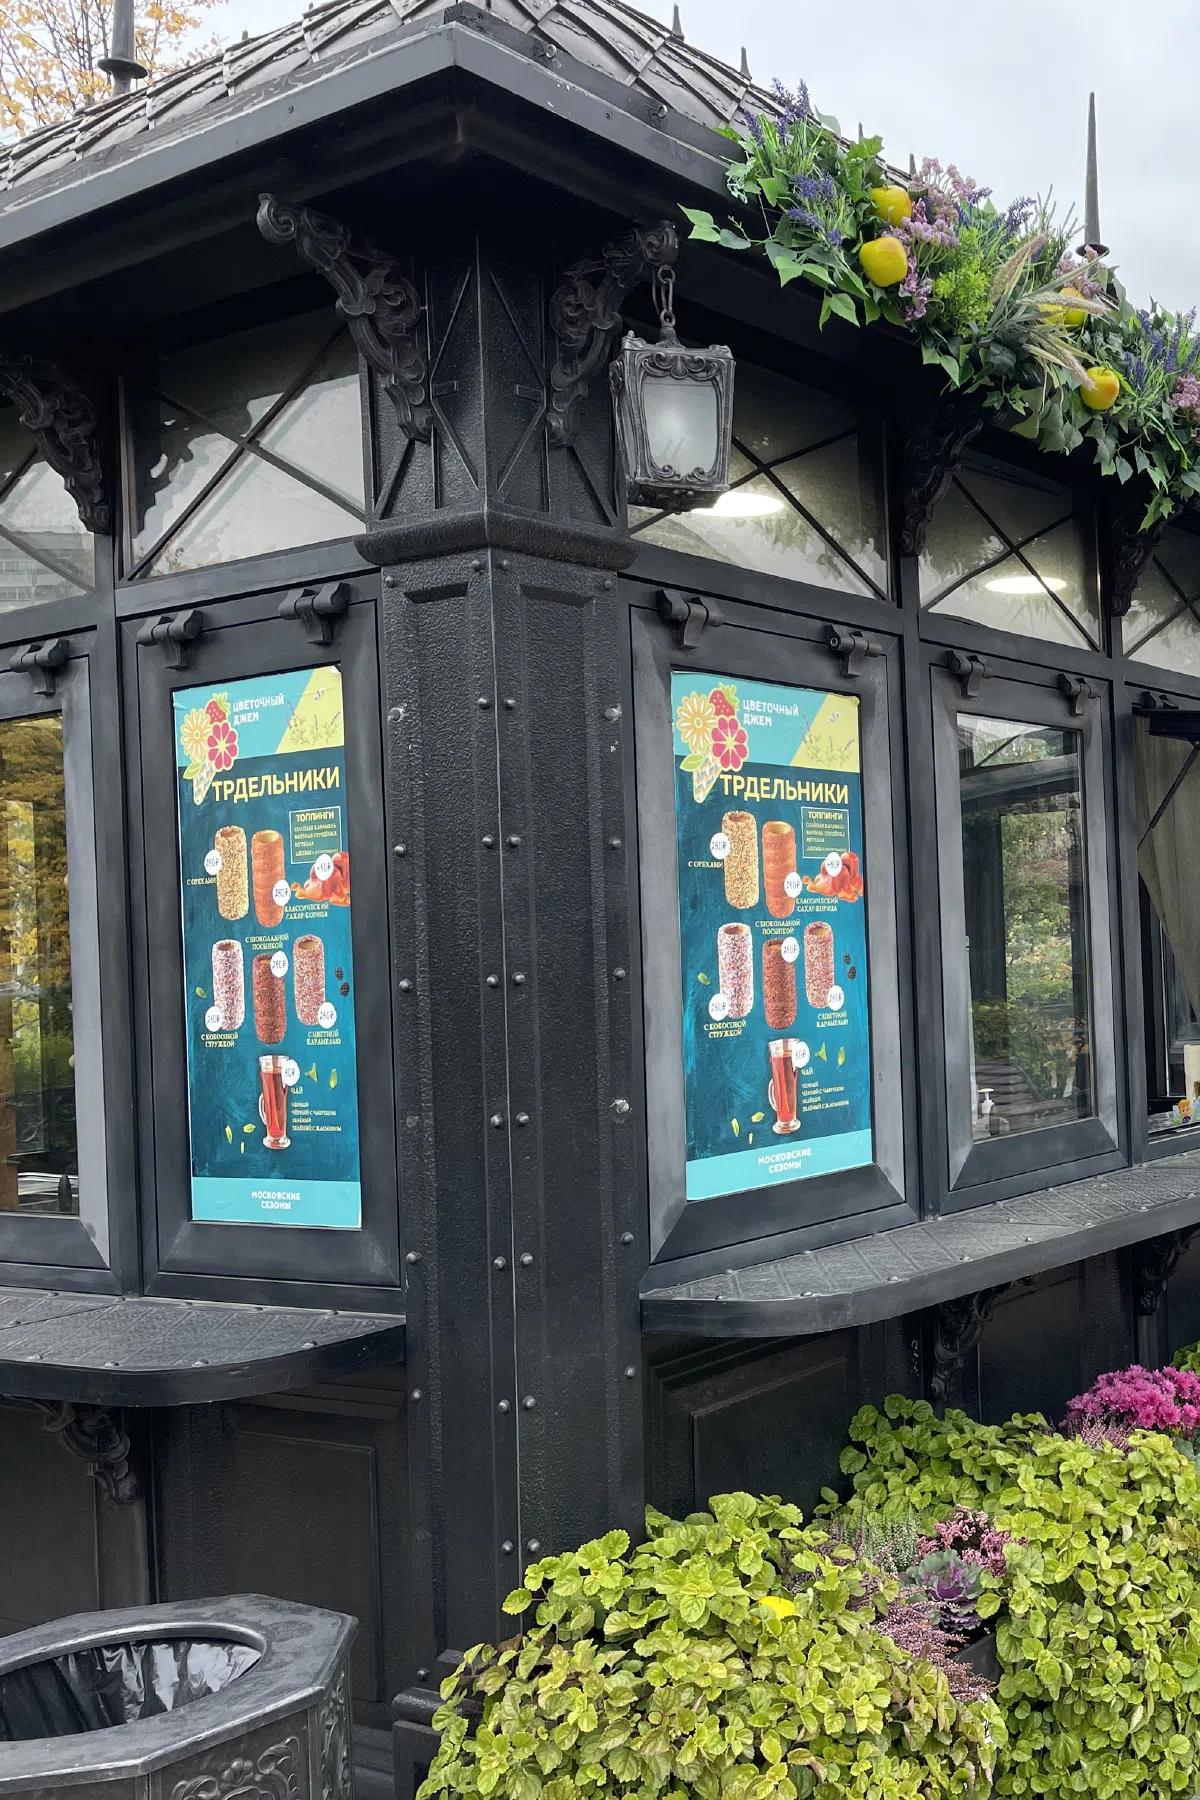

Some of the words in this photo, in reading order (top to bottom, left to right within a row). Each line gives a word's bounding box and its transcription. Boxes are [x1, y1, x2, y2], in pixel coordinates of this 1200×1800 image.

[233, 693, 284, 712] ЦВЕТОЧНЫЙ
[743, 700, 799, 717] ЦВЕТОЧНЫЙ
[233, 711, 259, 726] ДЖЕМ
[743, 713, 772, 727] ДЖЕМ
[212, 766, 340, 803] ТРДЕЛЬНИКИ
[720, 774, 849, 804] ТРДЕЛЬНИКИ
[296, 811, 334, 823] ТОППИНГИ
[808, 811, 843, 820] ТОППИНГИ
[796, 896, 838, 904] КЛАССИЧЕСКИЙ
[285, 902, 328, 912] КЛАССИЧЕСКИЙ
[760, 920, 800, 928] ШОКОЛАДНОЙ
[762, 927, 794, 935] ПОСЫПКОЙ
[250, 933, 289, 942] ШОКОЛАДНОЙ
[252, 942, 283, 950] ПОСЫПКОЙ
[709, 1019, 746, 1030] КОКОСОВОЙ
[206, 1032, 238, 1040] КОКОСОВОЙ
[312, 1029, 339, 1037] ЦВЕТНОЙ
[709, 1029, 742, 1039] СТРУЖКОЙ
[205, 1039, 234, 1048] СТРУЖКОЙ
[801, 1067, 813, 1075] ЧАЙ
[291, 1086, 303, 1094] ЧАЙ
[757, 1148, 812, 1165] МОСКОВСКИЕ
[768, 1160, 801, 1173] СЕЗОНЫ
[252, 1191, 300, 1200] МОСКОВСКИЕ
[261, 1201, 291, 1210] СЕЗОНЫ
